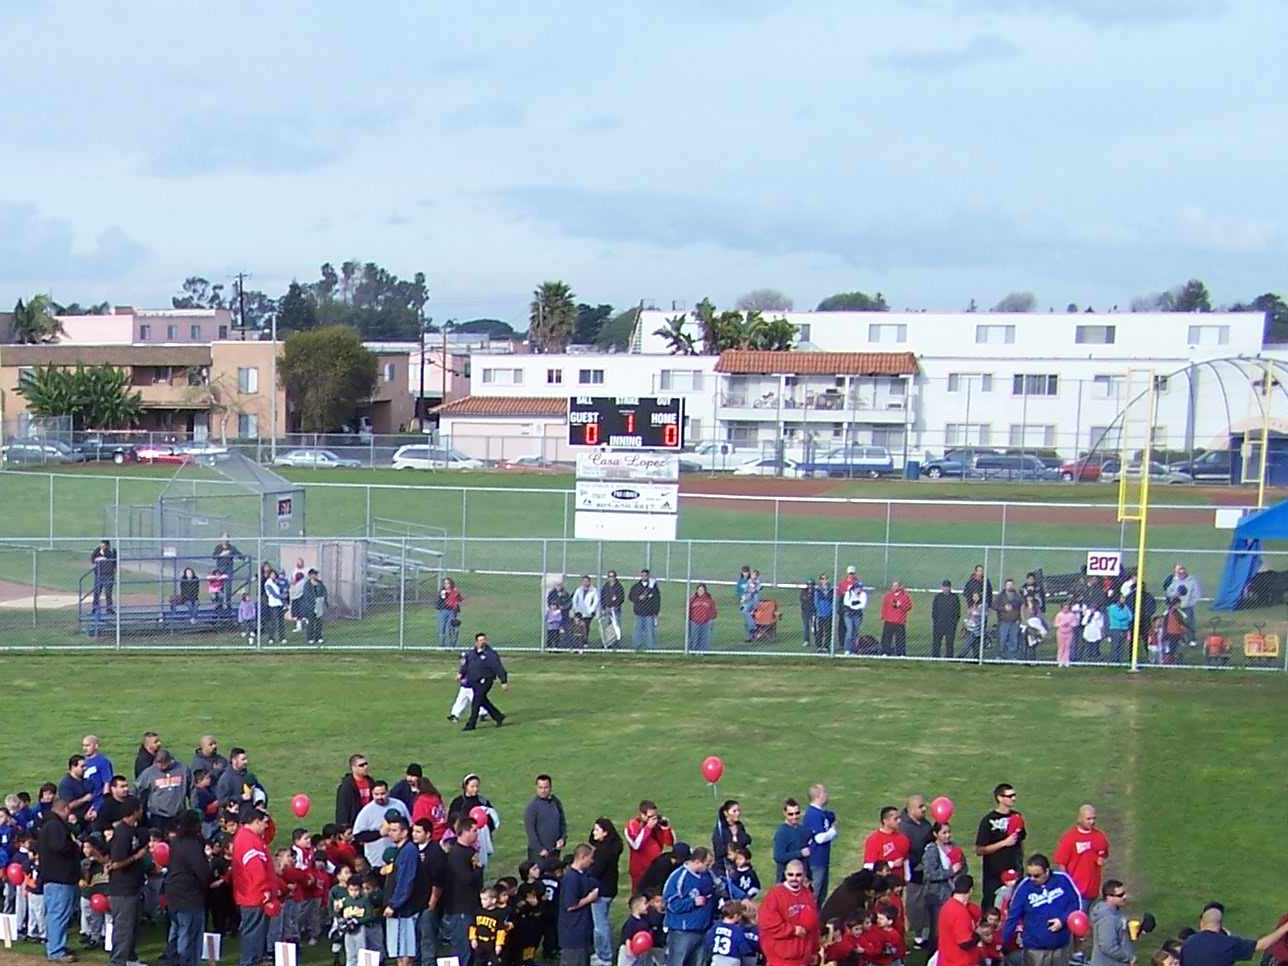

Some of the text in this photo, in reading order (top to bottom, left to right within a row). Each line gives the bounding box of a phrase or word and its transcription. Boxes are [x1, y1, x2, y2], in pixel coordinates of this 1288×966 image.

[570, 411, 599, 423] GUEST
[651, 412, 677, 424] HOME
[585, 424, 598, 444] 0
[609, 435, 642, 446] INNING
[664, 425, 677, 445] 0
[1089, 556, 1118, 570] 207
[713, 935, 732, 955] 13
